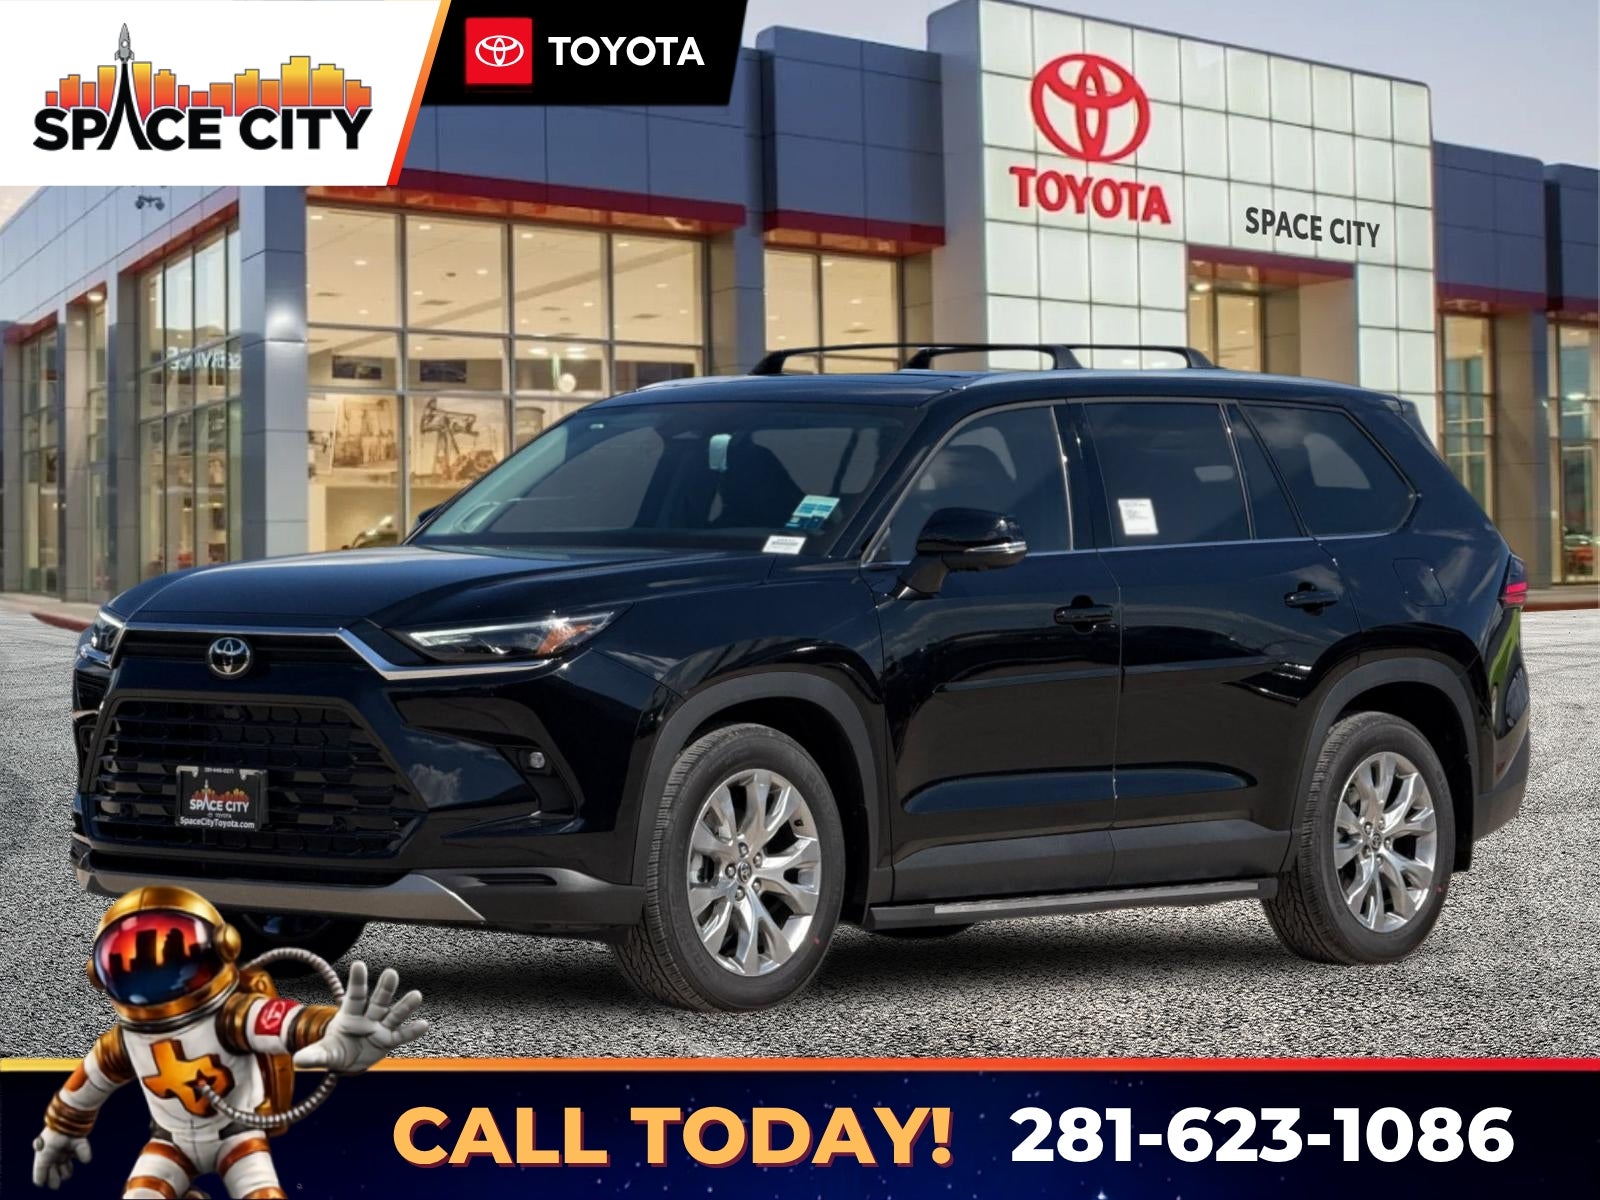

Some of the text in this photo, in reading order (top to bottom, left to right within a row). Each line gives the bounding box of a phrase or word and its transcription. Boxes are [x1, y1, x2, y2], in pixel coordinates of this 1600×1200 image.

[1009, 166, 1171, 225] TOYOTA
[1245, 206, 1380, 248] SPACE CITY
[189, 797, 249, 813] SPACE CITY
[180, 816, 255, 829] SpaceCityToyota.com
